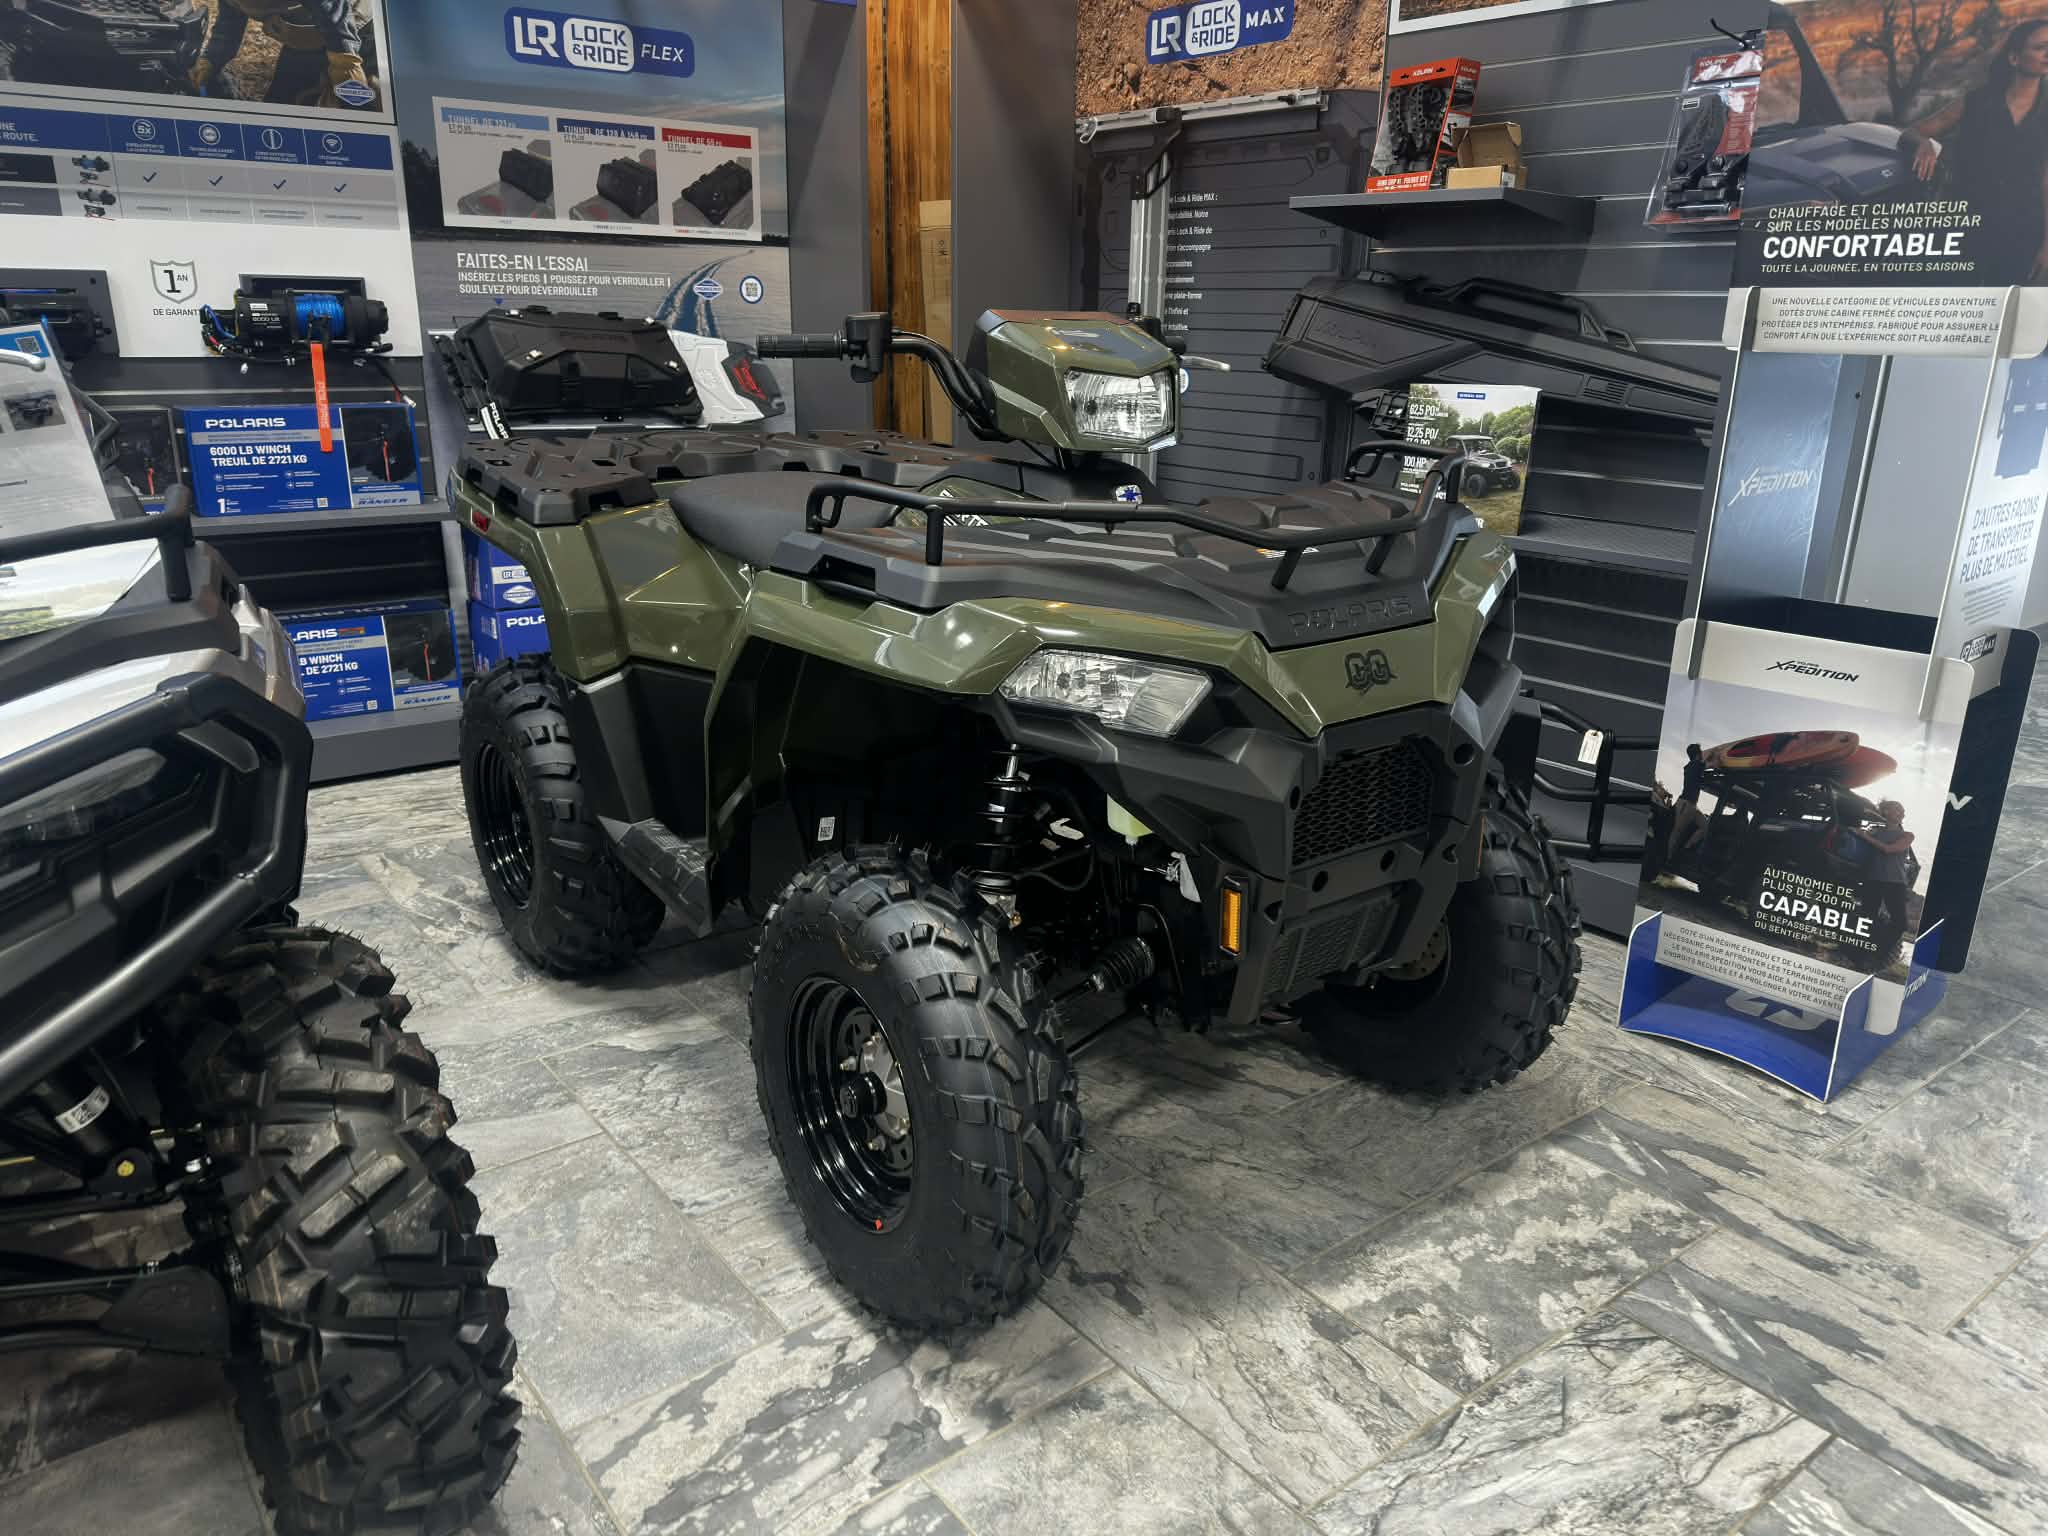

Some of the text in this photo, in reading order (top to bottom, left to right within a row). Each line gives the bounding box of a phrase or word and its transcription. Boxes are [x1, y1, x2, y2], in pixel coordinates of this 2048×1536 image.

[1192, 5, 1236, 28] LOCK
[1246, 6, 1285, 28] MAX
[571, 24, 626, 46] LOCK
[641, 44, 684, 63] FLEX
[563, 125, 592, 136] TUNNEL
[595, 128, 604, 136] DE
[1769, 200, 1968, 218] CHAUFFAGE ET CLIMATISEUR
[1767, 214, 1982, 232] SUR LES MODÈLES NORTHSTAR
[1763, 232, 1964, 258] CONFORTABLE
[457, 252, 589, 272] FAITES-EN L'ESSAI
[1762, 264, 1792, 273] TOUTE
[1795, 264, 1807, 272] LA
[1864, 263, 1878, 272] EN
[1882, 262, 1922, 272] TOUTES
[1926, 262, 1976, 272] SAISONS
[164, 269, 188, 294] 1 AN
[458, 271, 664, 286] INSÉREZ LES PIEDS POUSSEZ POUR VERROUILLER
[460, 284, 504, 294] SOULEVEZ
[506, 286, 530, 295] POUR
[1790, 298, 1831, 306] NOUVELLE
[1833, 297, 1878, 306] CATÉGORIE
[1880, 298, 1892, 306] DE
[1894, 297, 1940, 306] VÉHICULES
[1942, 298, 1997, 306] D'AVENTURE
[153, 308, 164, 316] DE
[1780, 309, 1804, 317] DOTÉS
[1862, 309, 1896, 318] FERMÉE
[1898, 310, 1933, 318] CONÇUE
[1934, 310, 1958, 318] POUR
[1960, 310, 1984, 318] VOUS
[1761, 320, 1802, 328] PROTÉGER
[1920, 322, 1944, 330] POUR
[1946, 322, 1990, 331] ASSURER
[1800, 332, 1818, 340] AFIN
[1839, 333, 1896, 341] L'EXPÉRIENCE
[1897, 334, 1917, 342] SOIT
[206, 418, 286, 428] POLARIS
[210, 444, 292, 456] 6000 LB WINCH
[212, 454, 308, 467] TREUIL DE 2721 KG
[1972, 495, 2040, 530] D'AUTRES FAÇONS
[1968, 520, 2034, 556] DE TRANSPORTER
[1960, 560, 1982, 584] PLUS
[1982, 556, 1994, 576] DE
[1288, 599, 1413, 636] POLARIS
[306, 662, 358, 675] DE 2721 KG
[308, 653, 342, 664] WINCH
[1765, 660, 1860, 682] XPEDITION
[1762, 878, 1794, 894] PLUS
[1796, 887, 1814, 899] DE
[1816, 892, 1838, 906] 200
[1764, 867, 1854, 898] AUTONOMIE DE
[1754, 920, 1768, 930] DU
[1760, 892, 1874, 938] CAPABLE
[1756, 911, 1878, 952] DE LES LIMITES
[1682, 946, 1710, 959] POLARIS
[1710, 954, 1746, 971] XPEDITION
[1748, 967, 1767, 978] VOUS
[1768, 973, 1784, 982] AIDE
[1792, 980, 1832, 998] ATTEINDRE
[1706, 944, 1724, 954] POUR
[1724, 950, 1766, 967] AFFRONTER
[1767, 964, 1780, 972] LES
[1783, 968, 1818, 983] TERRAINS
[1820, 979, 1849, 994] DIFFICIL
[1782, 958, 1792, 966] DE
[1804, 965, 1846, 982] PUISSANCE
[1745, 975, 1787, 993] PROLONGER
[1788, 988, 1812, 1001] VOTRE
[1814, 998, 1842, 1010] AVENTU
